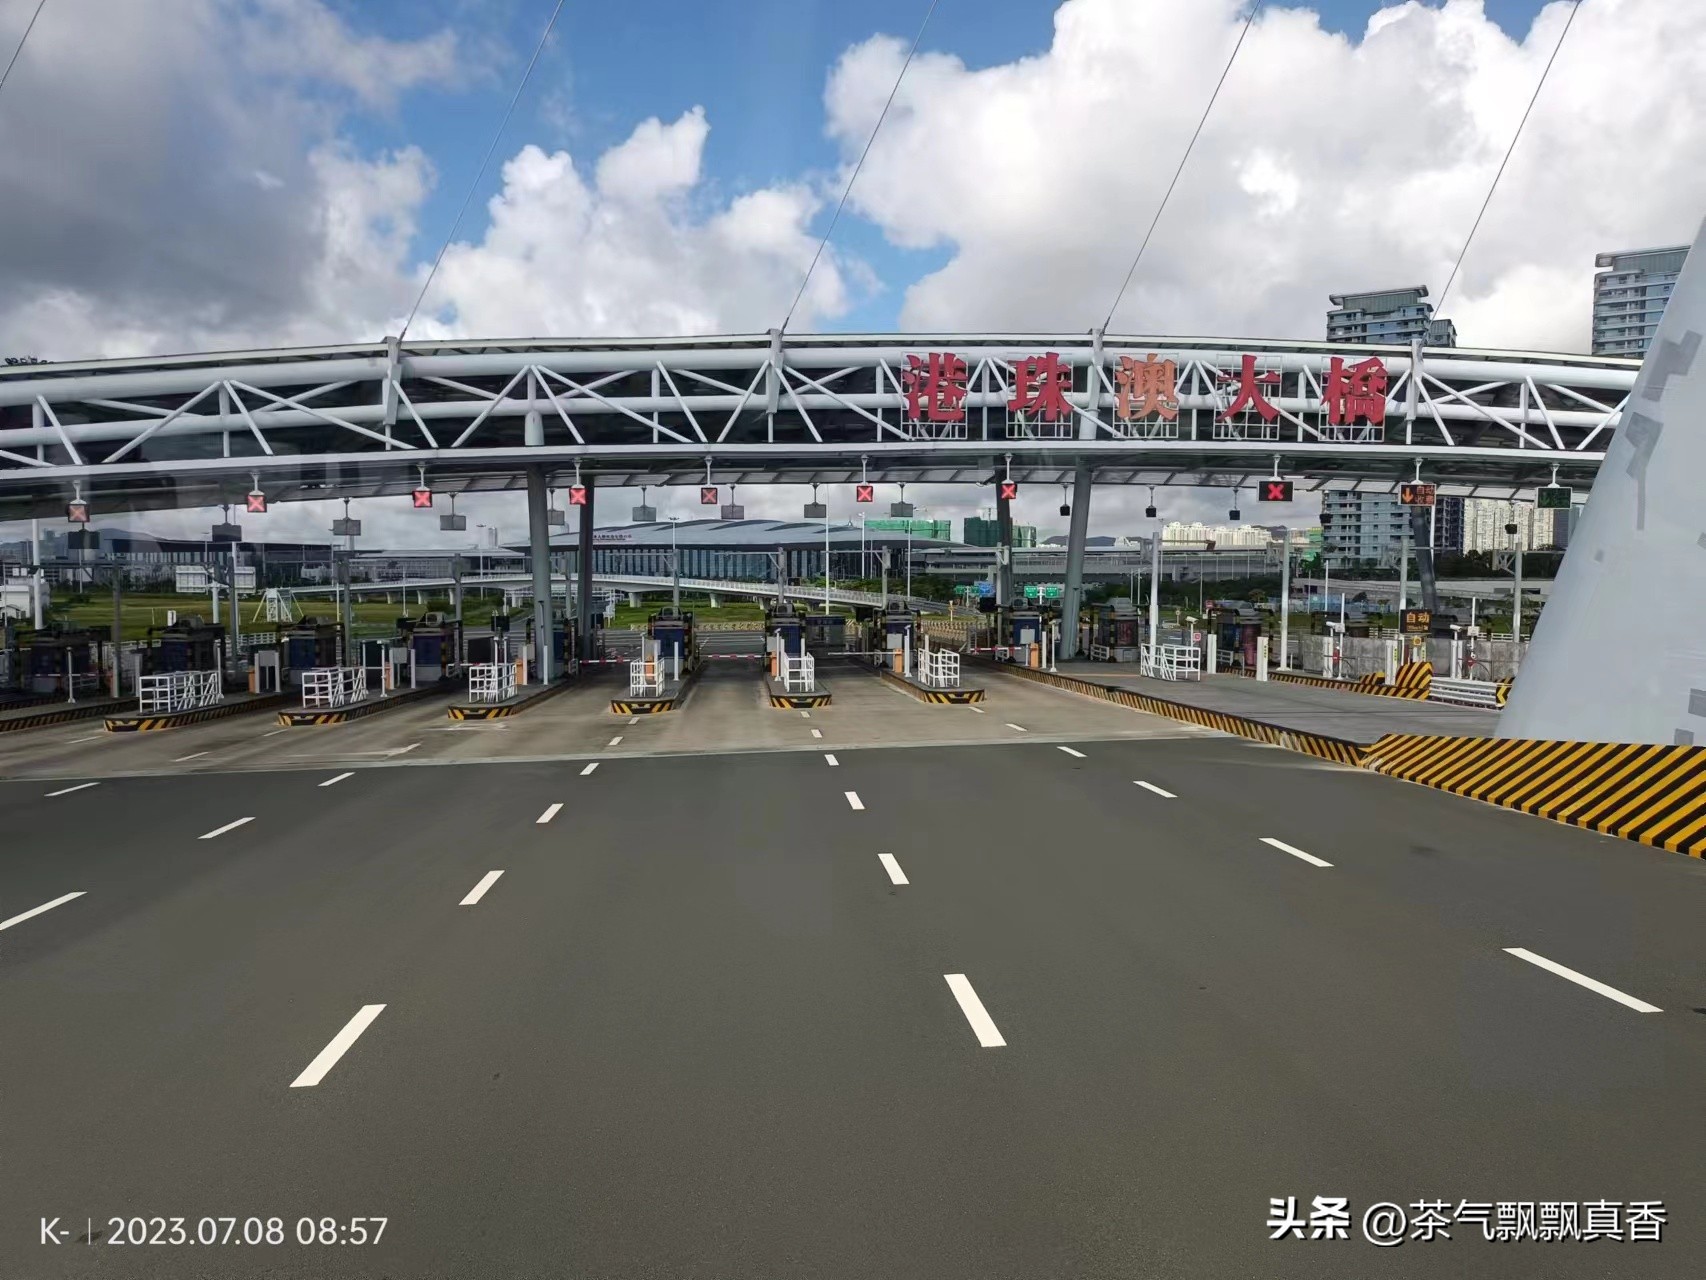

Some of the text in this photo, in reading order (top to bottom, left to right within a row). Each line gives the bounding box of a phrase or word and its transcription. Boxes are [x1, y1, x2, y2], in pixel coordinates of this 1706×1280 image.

[904, 352, 1388, 425] 港珠澳大橋
[1416, 485, 1435, 494] 自动
[1406, 612, 1430, 623] 自动
